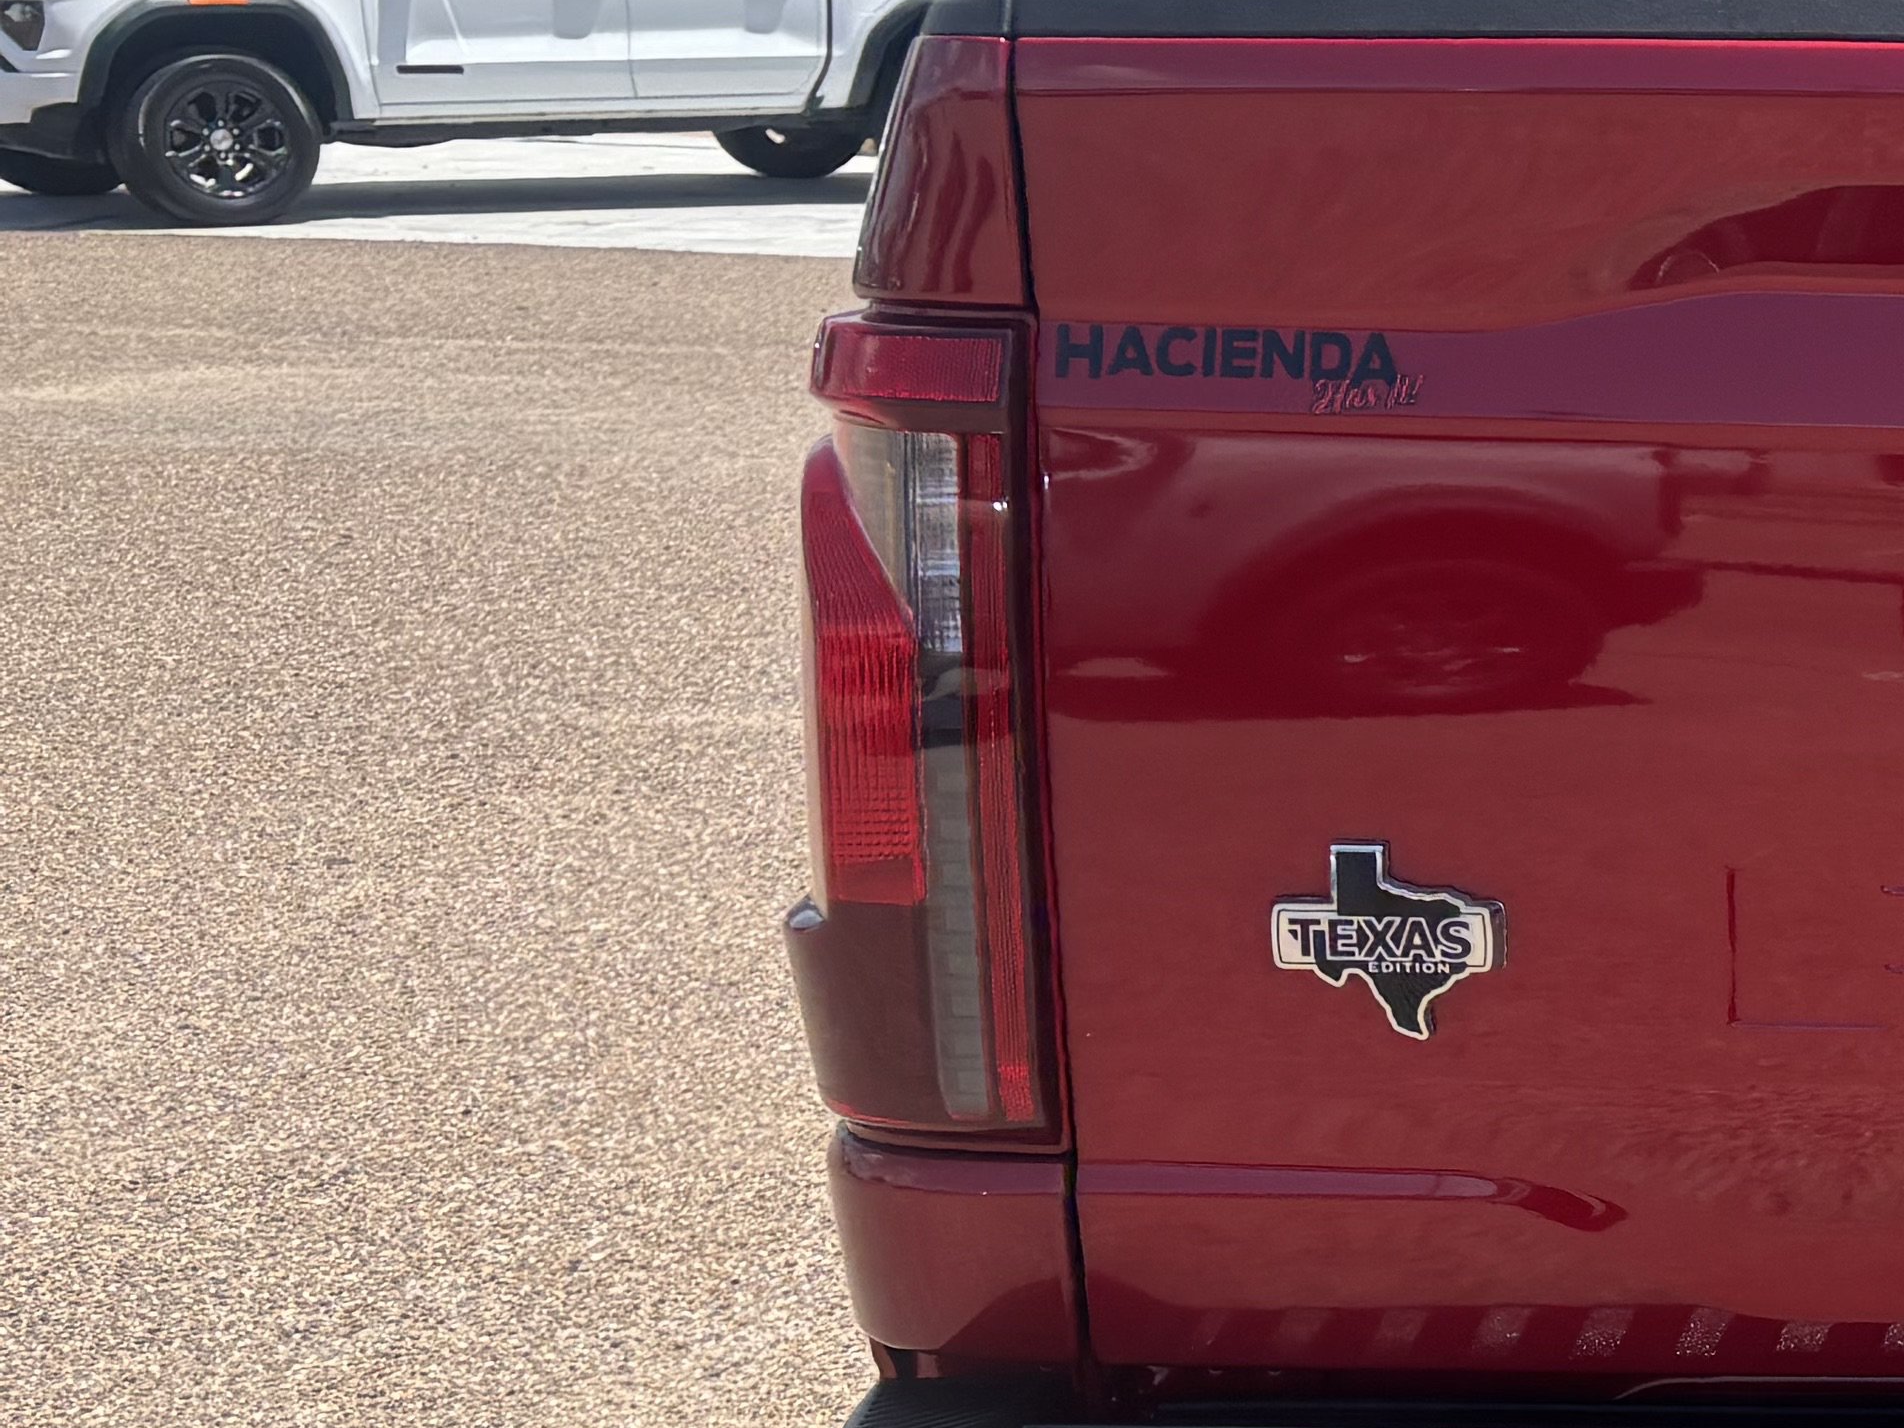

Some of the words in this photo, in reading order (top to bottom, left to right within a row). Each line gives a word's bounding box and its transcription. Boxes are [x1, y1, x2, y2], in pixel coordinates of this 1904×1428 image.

[1055, 323, 1397, 385] HACIENDA
[1288, 916, 1473, 961] TEXAS
[1367, 961, 1450, 974] EDITION
